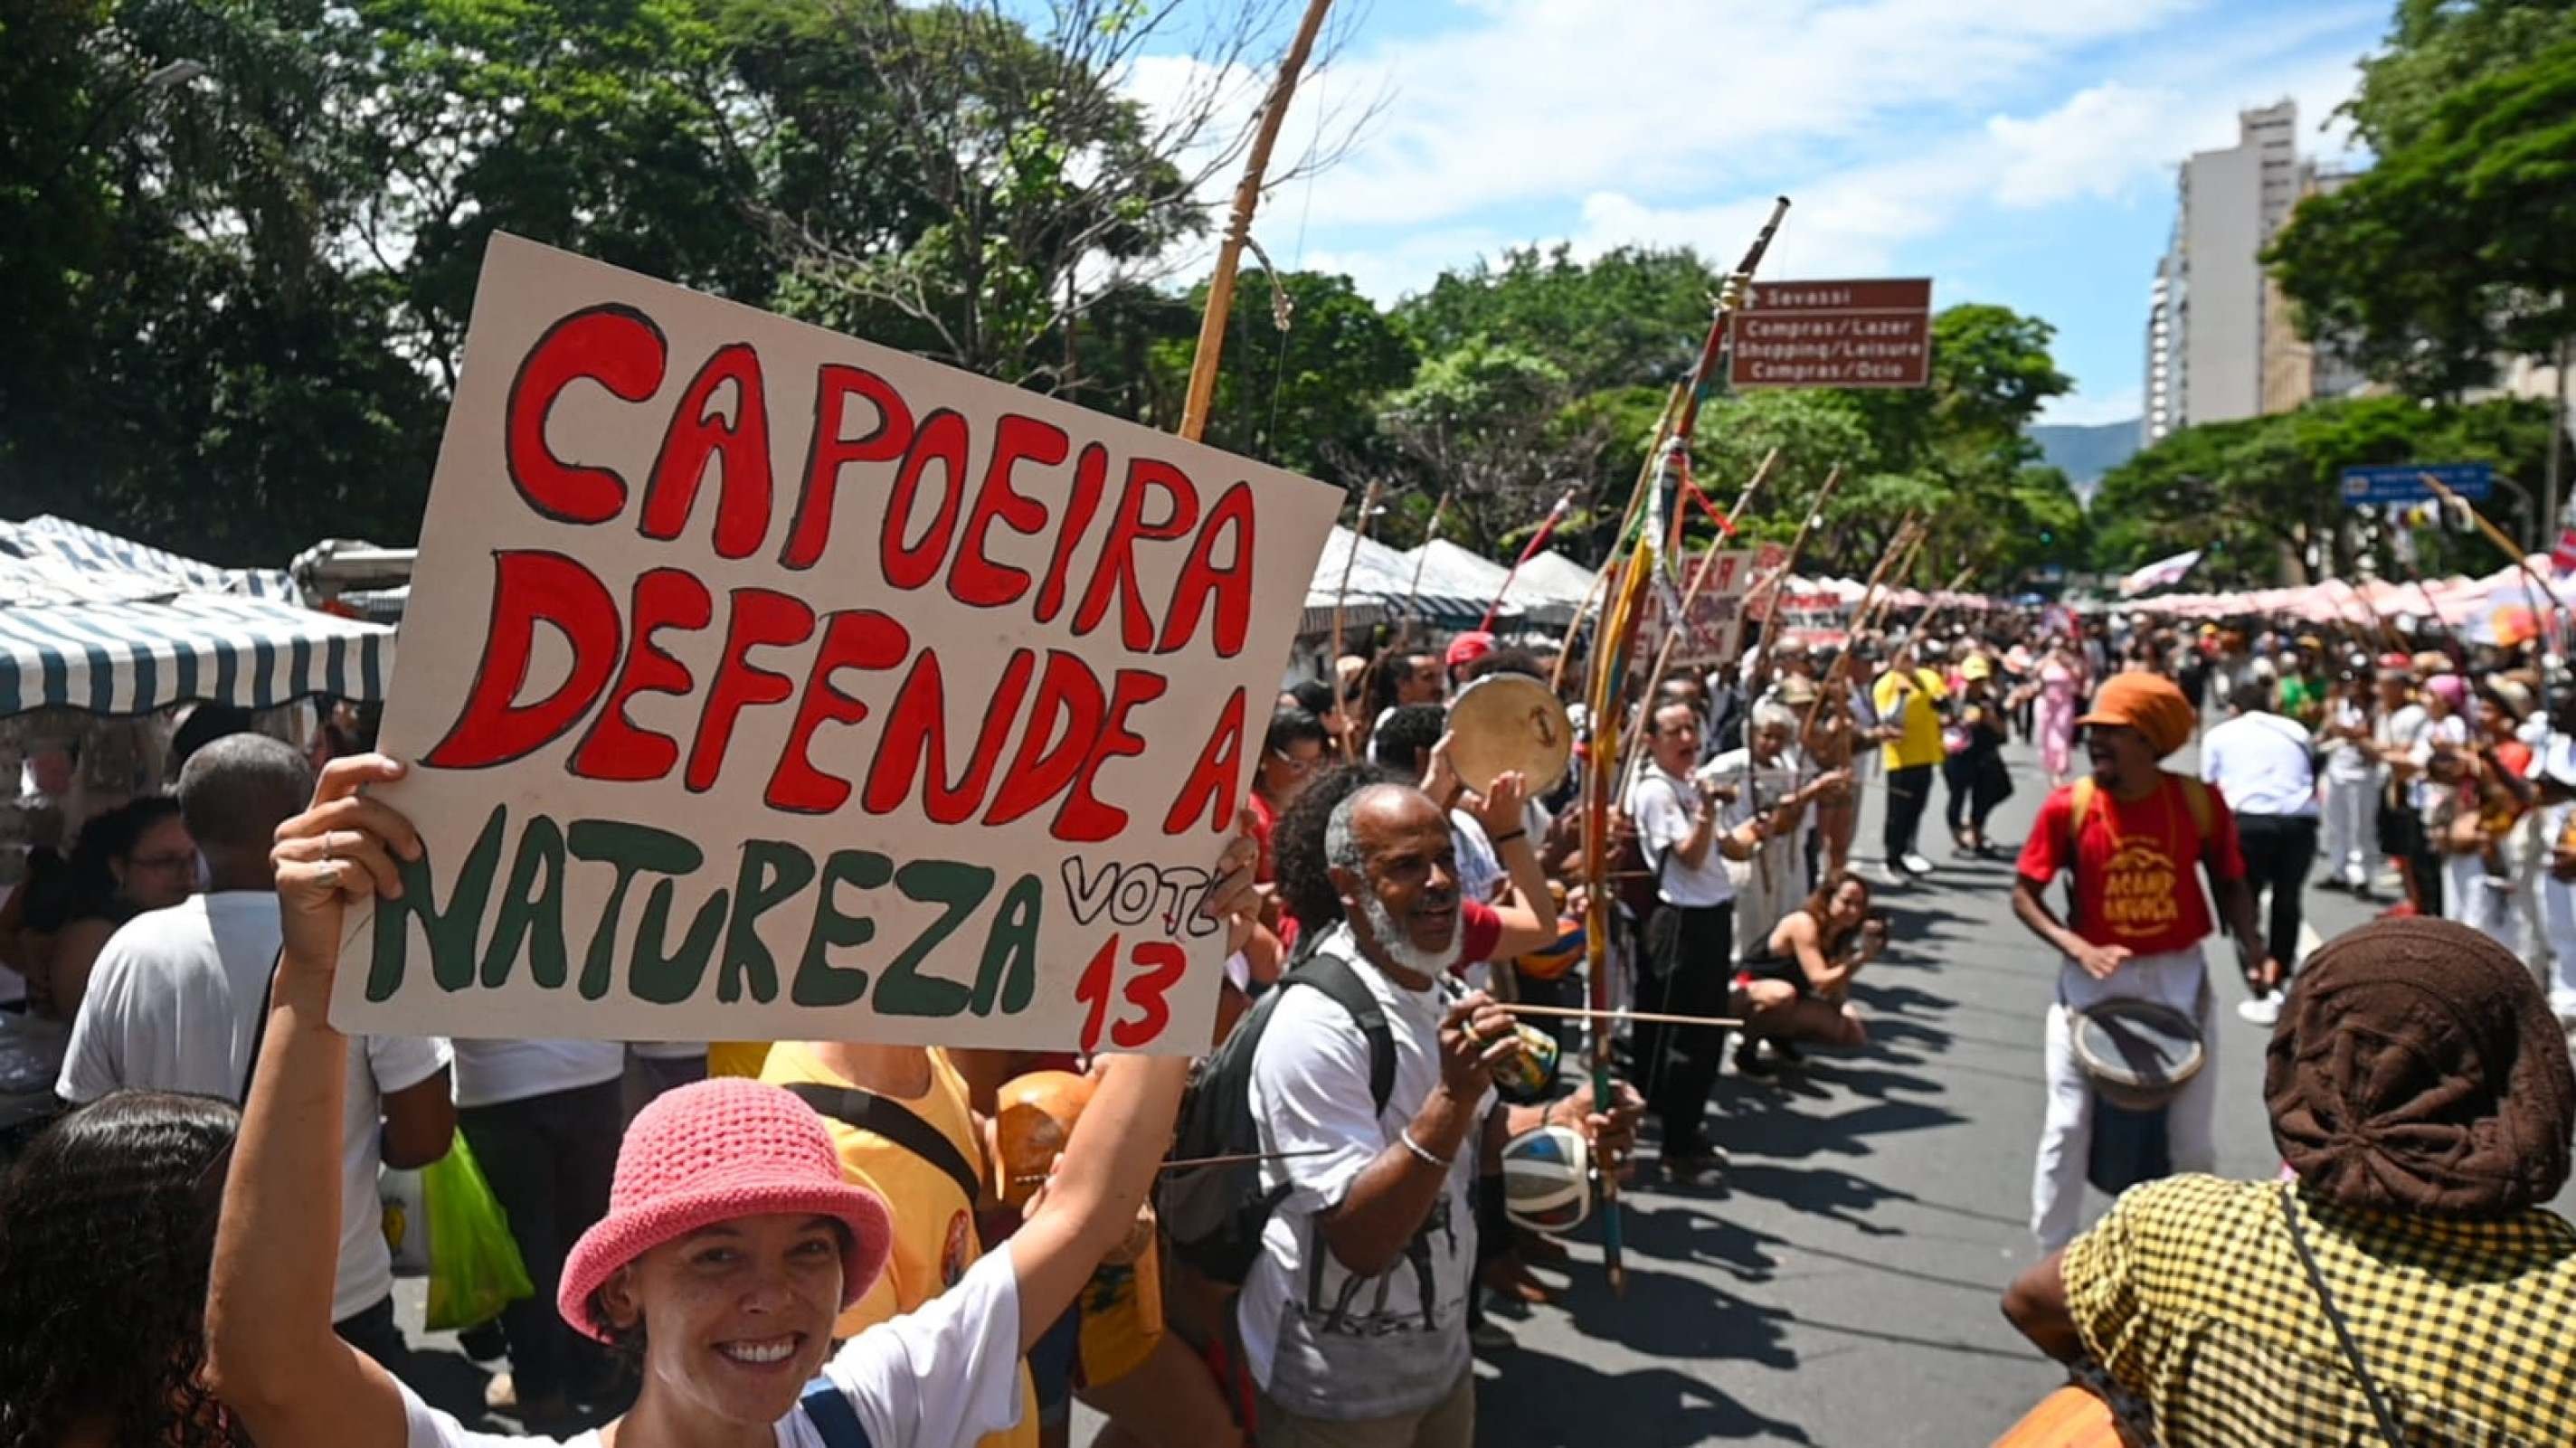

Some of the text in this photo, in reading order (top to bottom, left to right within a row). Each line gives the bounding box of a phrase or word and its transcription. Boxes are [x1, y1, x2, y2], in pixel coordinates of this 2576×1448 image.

[1737, 340, 1921, 359] Shopping/Leisure
[1746, 319, 1913, 337] Compras/Lazer
[1766, 289, 1852, 306] Savassi
[506, 303, 1255, 658] CAPOEIRA
[415, 549, 1246, 842] DEFENDE A
[365, 803, 1042, 1017] NATUREZA
[1075, 932, 1188, 1052] 13
